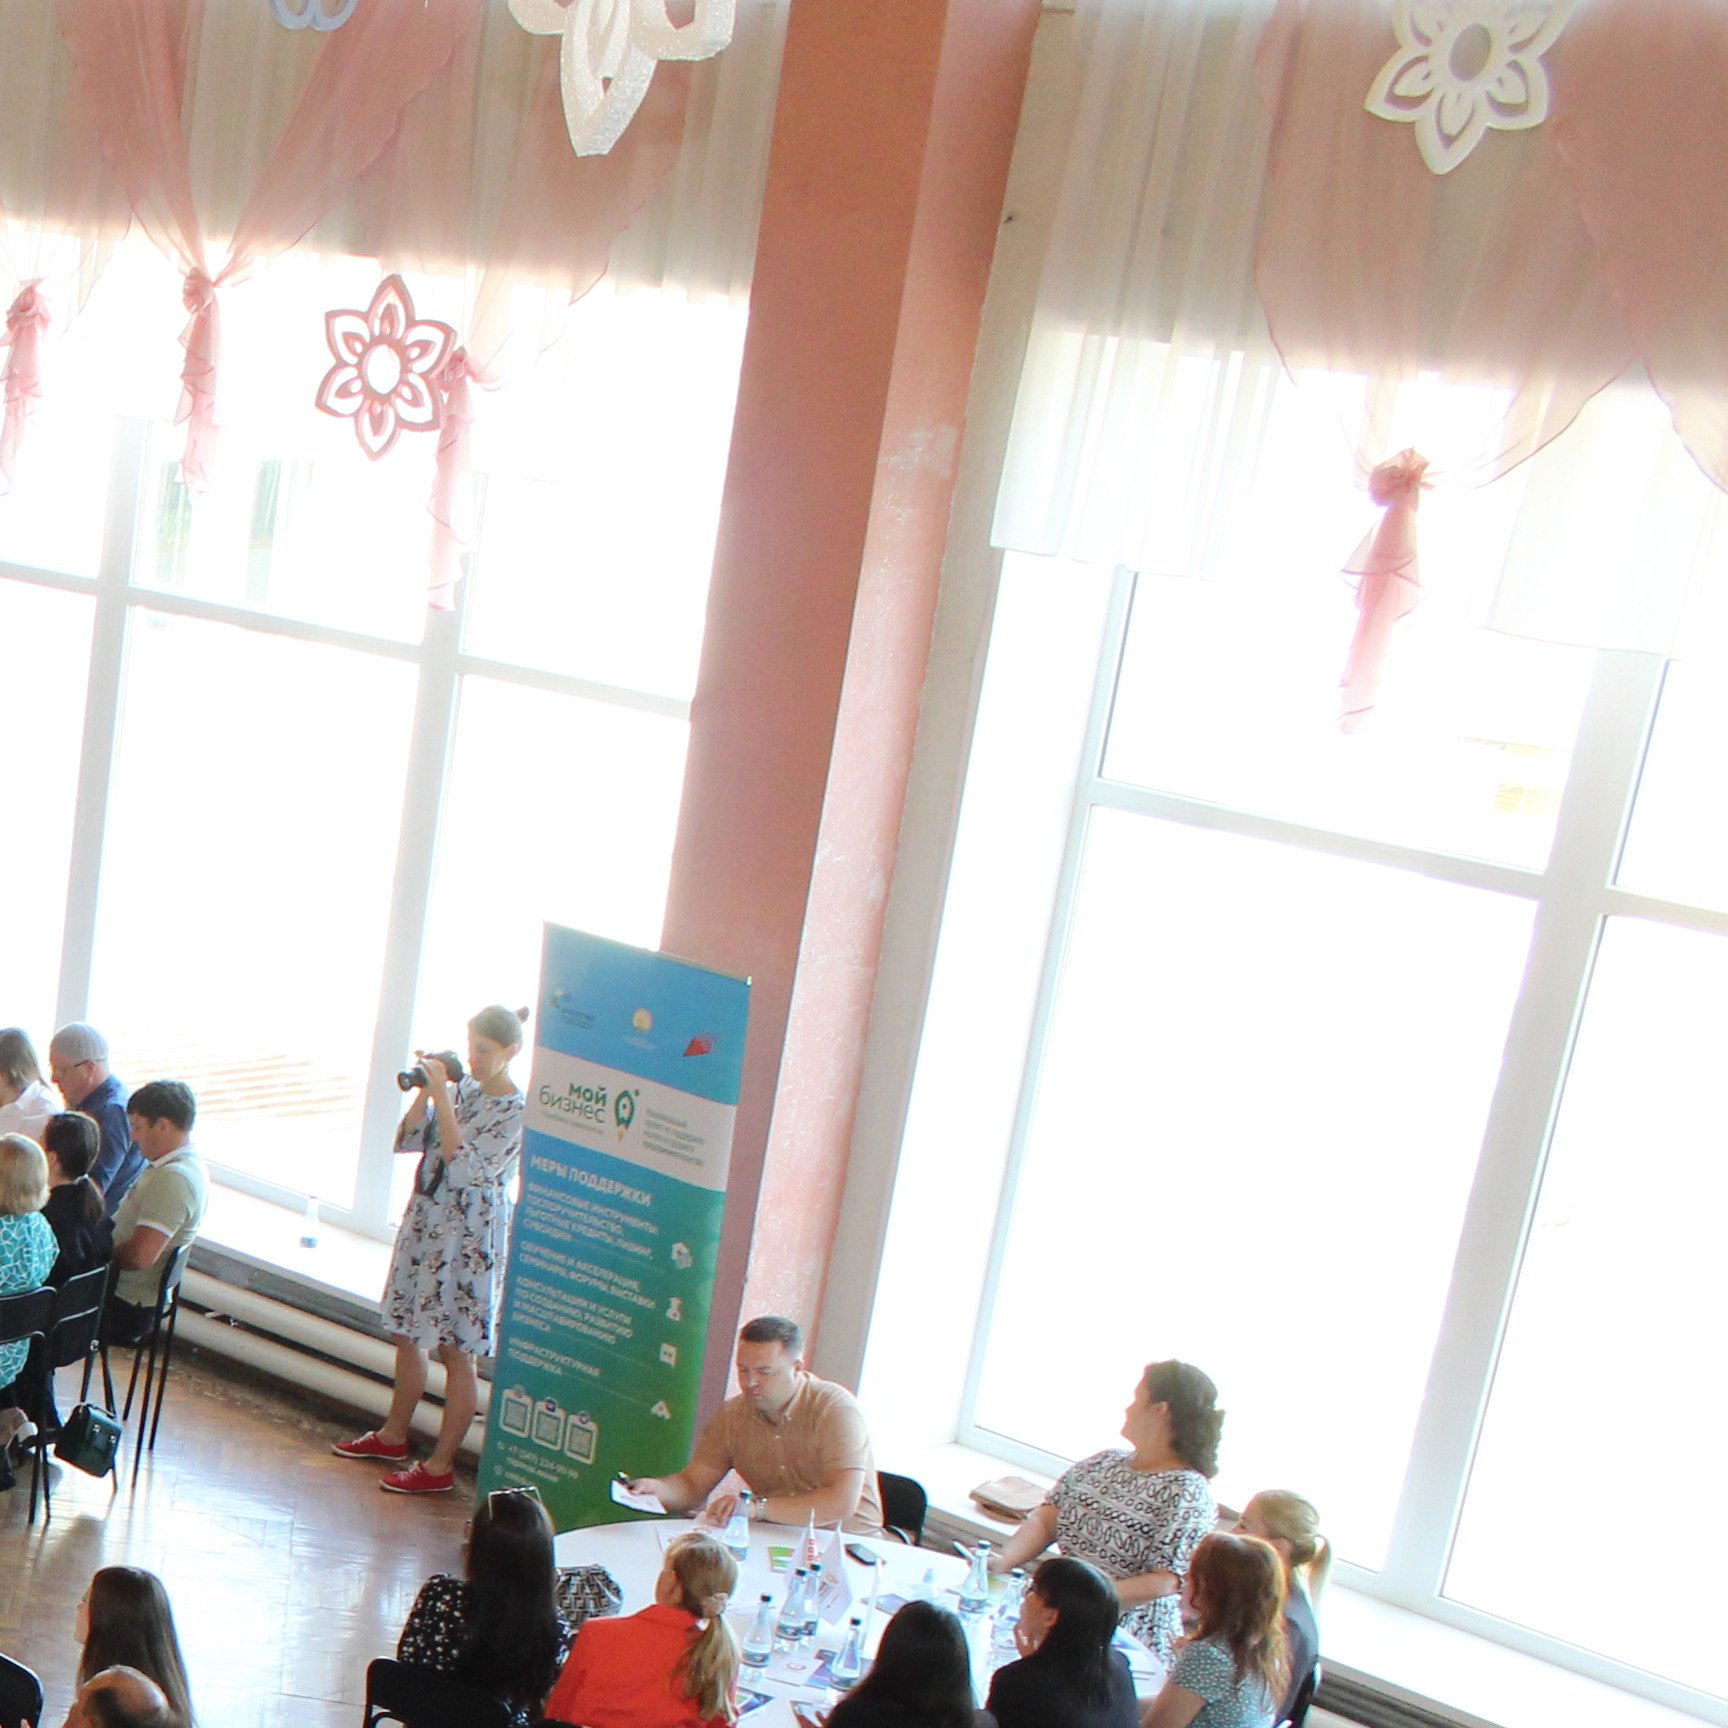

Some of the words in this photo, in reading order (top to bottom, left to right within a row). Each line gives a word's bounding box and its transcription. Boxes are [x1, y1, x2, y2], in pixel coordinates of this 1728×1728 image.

[539, 1085, 607, 1124] бизнес
[530, 1155, 569, 1179] МЕРЫ
[569, 1167, 654, 1207] ПОДДЕРЖКИ
